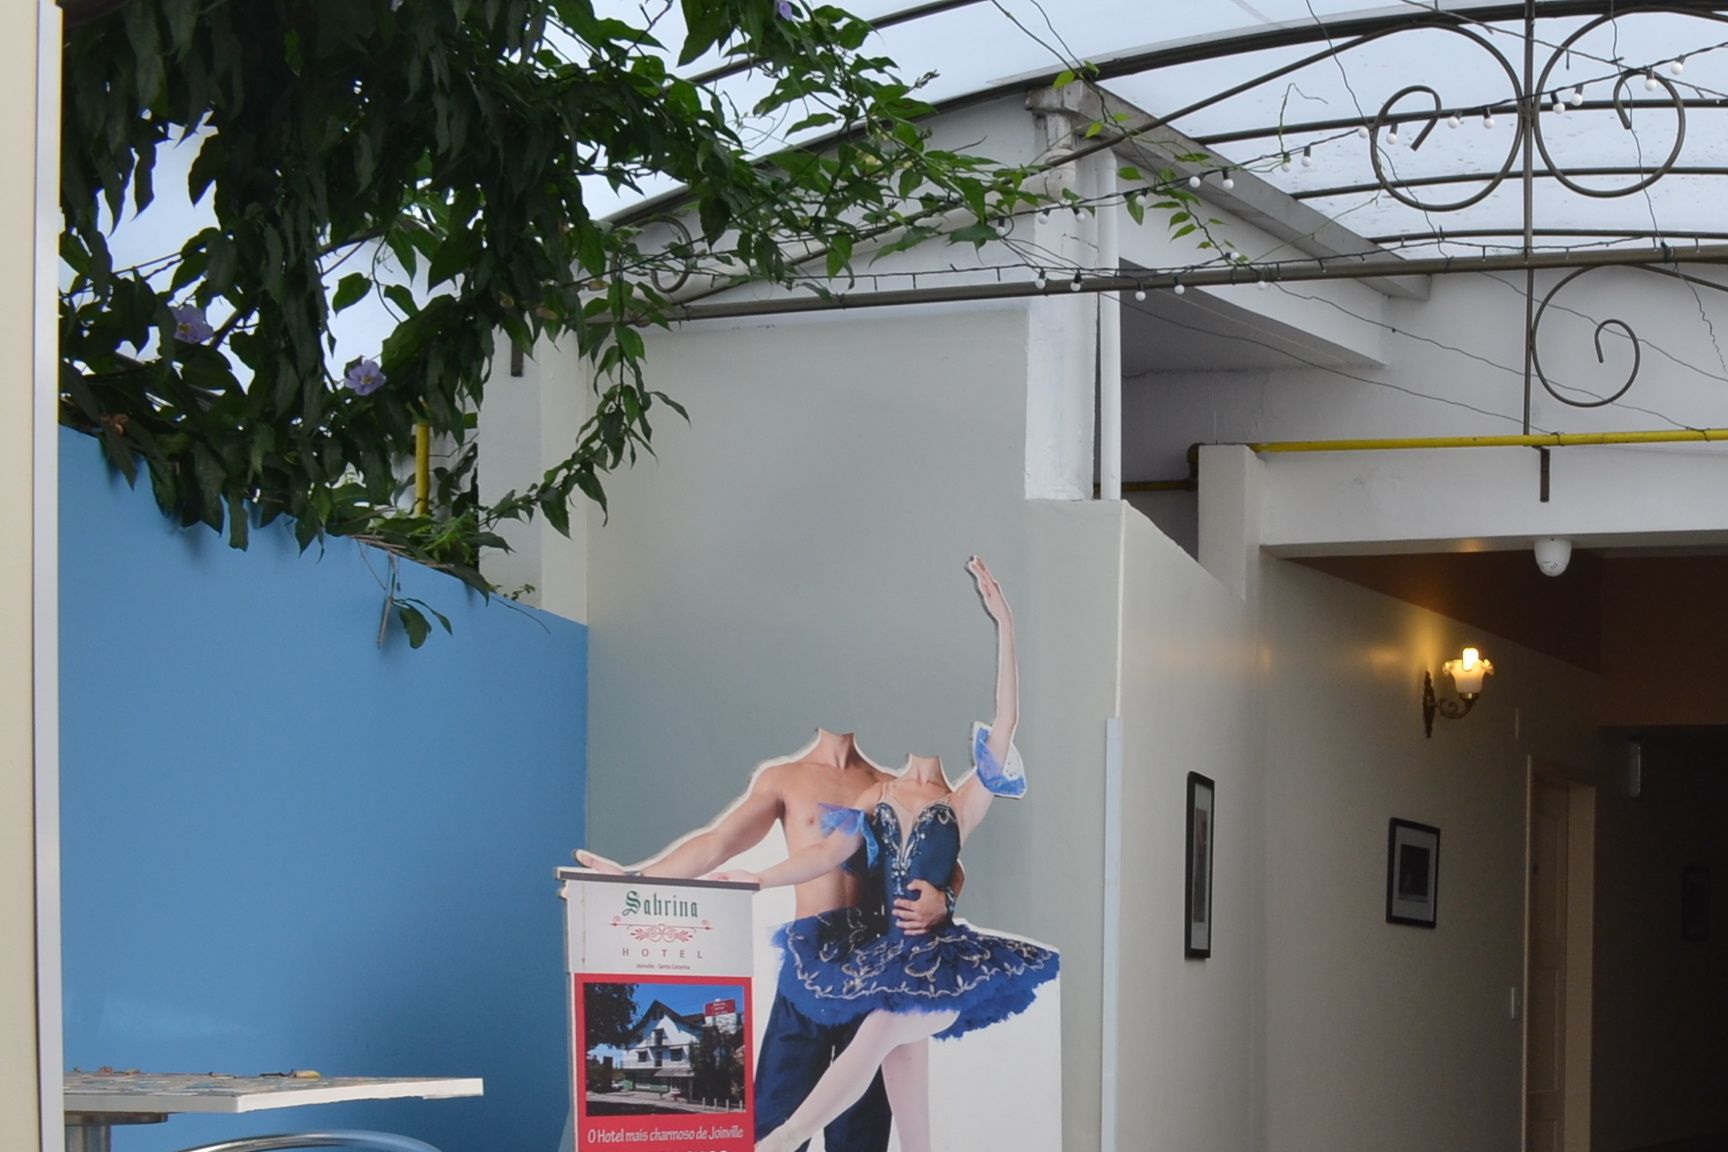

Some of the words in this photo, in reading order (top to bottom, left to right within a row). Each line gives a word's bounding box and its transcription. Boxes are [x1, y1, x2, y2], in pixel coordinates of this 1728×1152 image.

[622, 890, 699, 918] Sabrina
[587, 1128, 596, 1144] O
[597, 1127, 625, 1143] Hotel
[625, 1128, 649, 1142] mais
[650, 1127, 695, 1142] charmoso
[695, 1125, 708, 1139] de
[708, 1124, 744, 1140] Joinville
